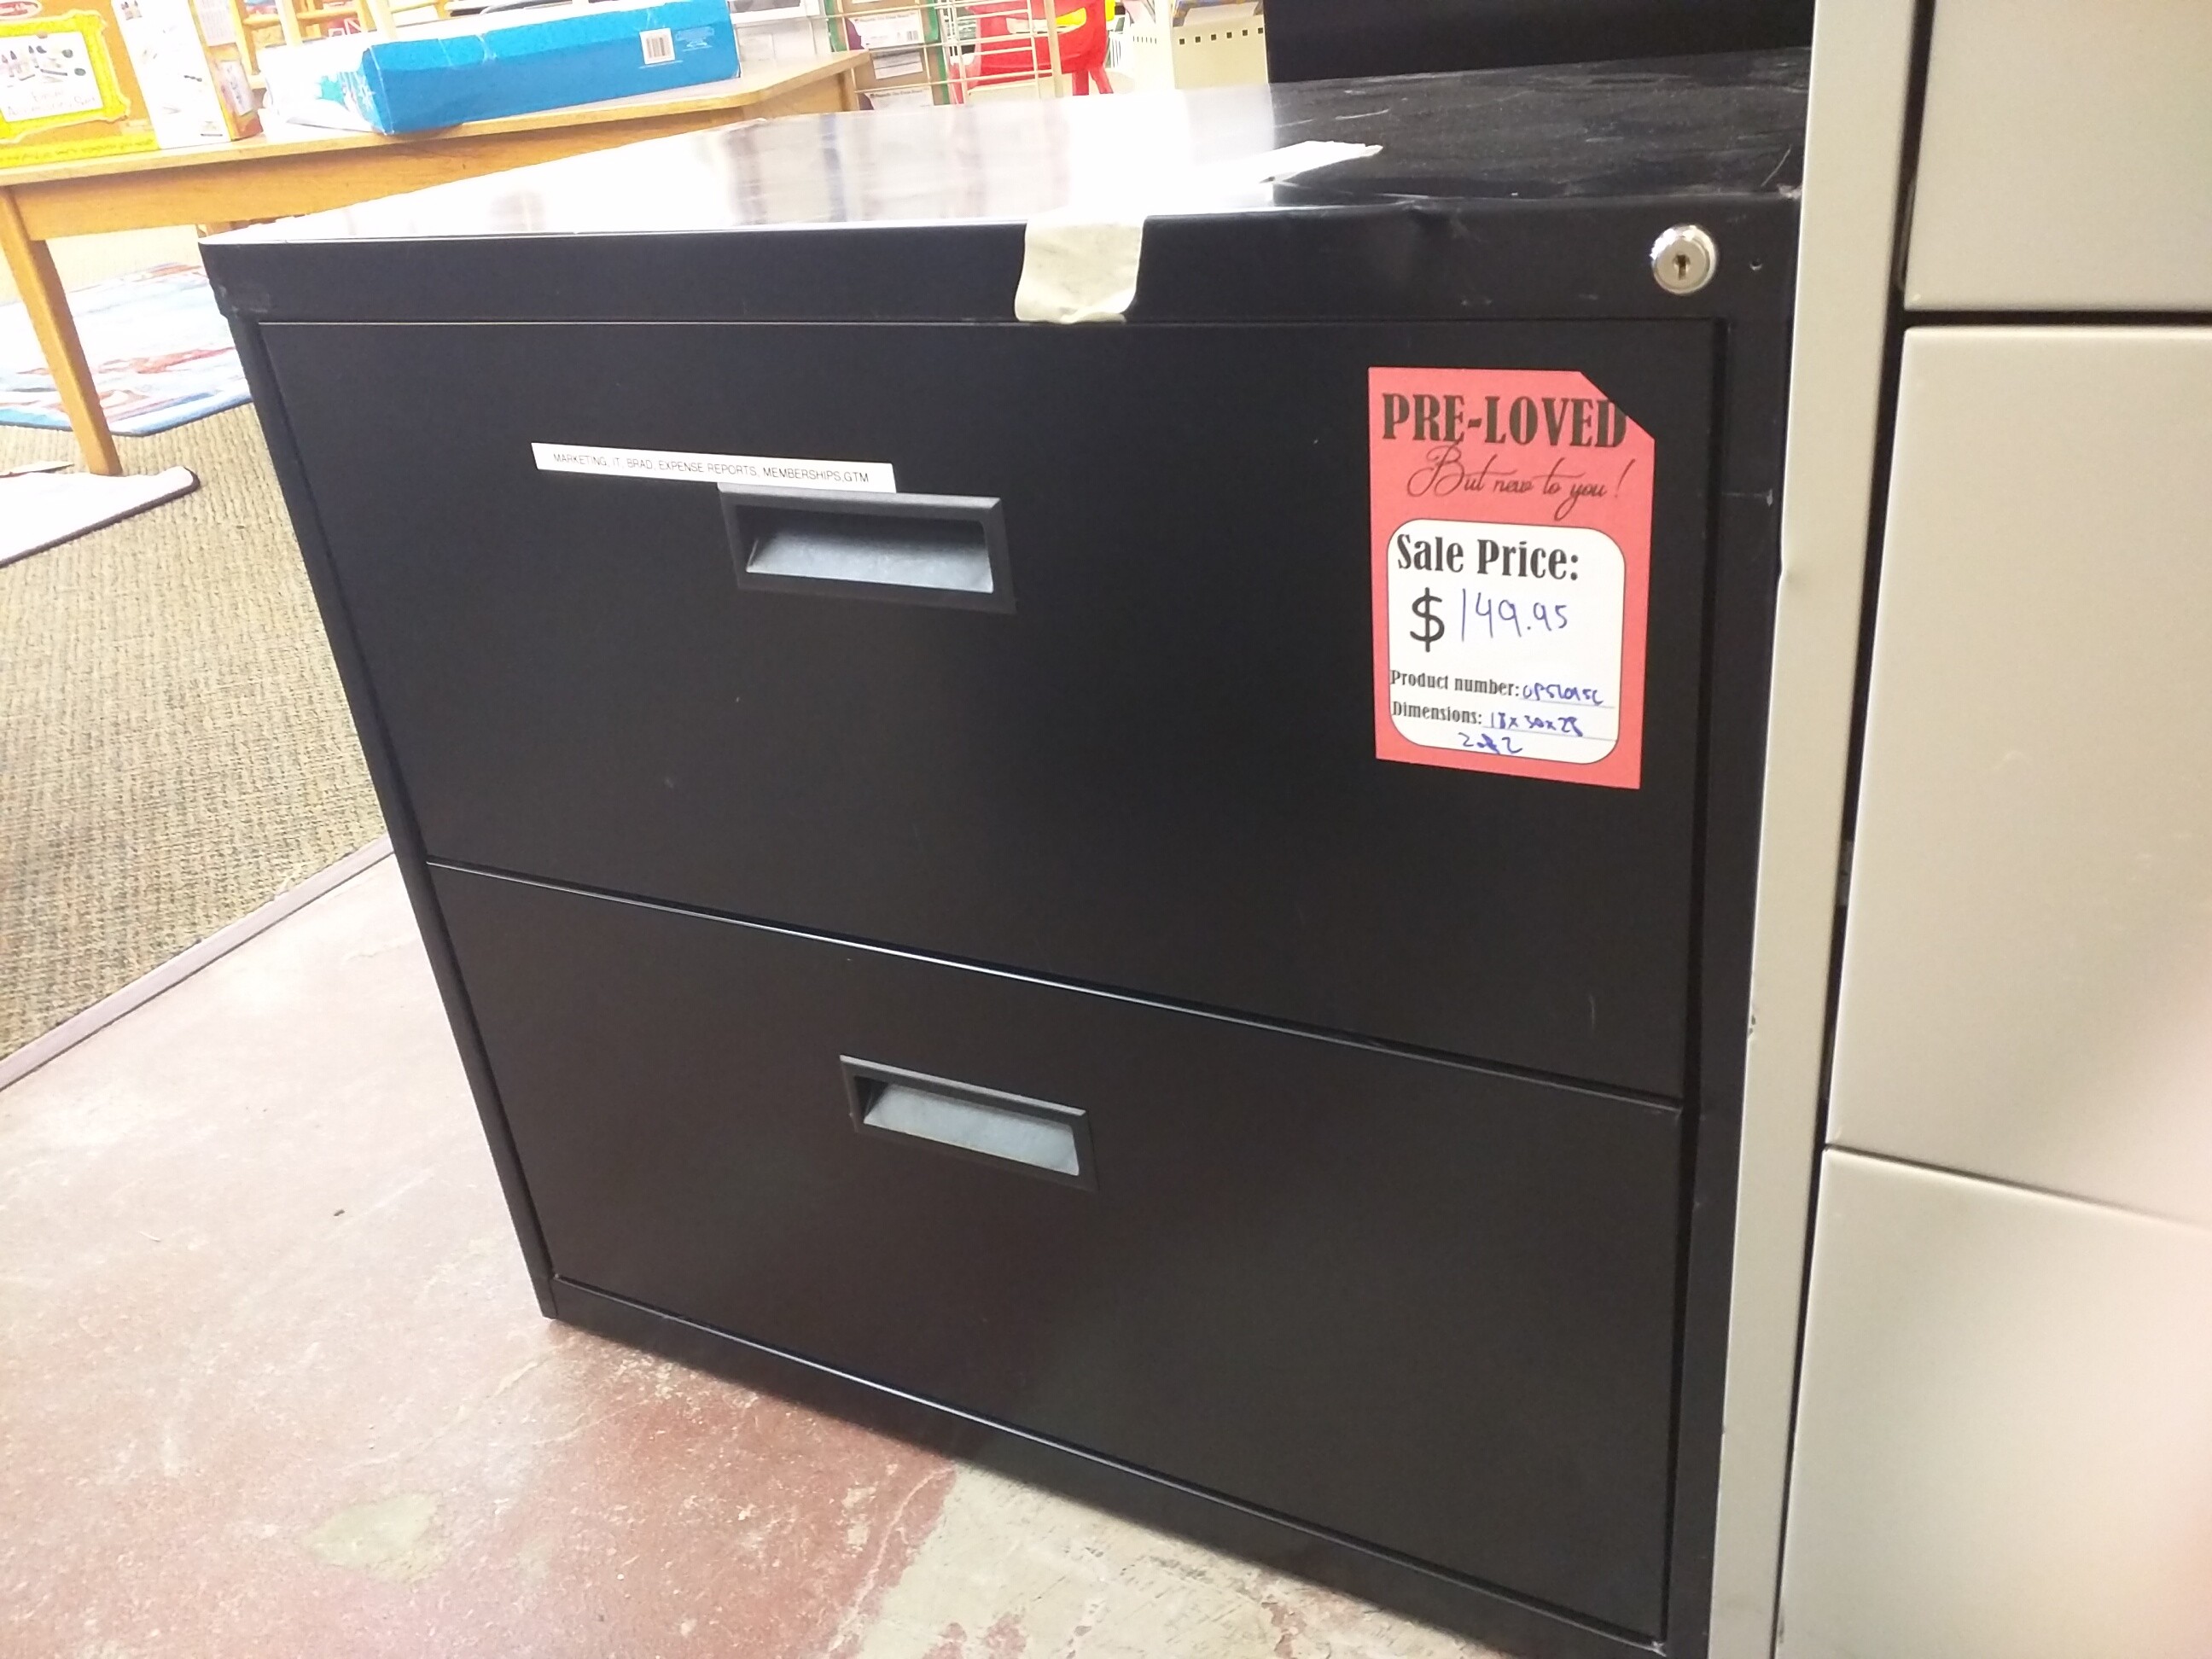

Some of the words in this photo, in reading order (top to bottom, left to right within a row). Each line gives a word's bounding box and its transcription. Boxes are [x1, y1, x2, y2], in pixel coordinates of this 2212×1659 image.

[1382, 393, 1627, 448] PRE-LOVED
[658, 459, 704, 473] EXPENSE
[1408, 440, 1517, 498] But
[1534, 457, 1586, 496] to
[1397, 534, 1464, 573] Sale
[1477, 539, 1580, 581] Price:
[1390, 669, 1449, 690] Product
[1454, 677, 1520, 697] number:
[1392, 700, 1482, 725] Dimensions:
